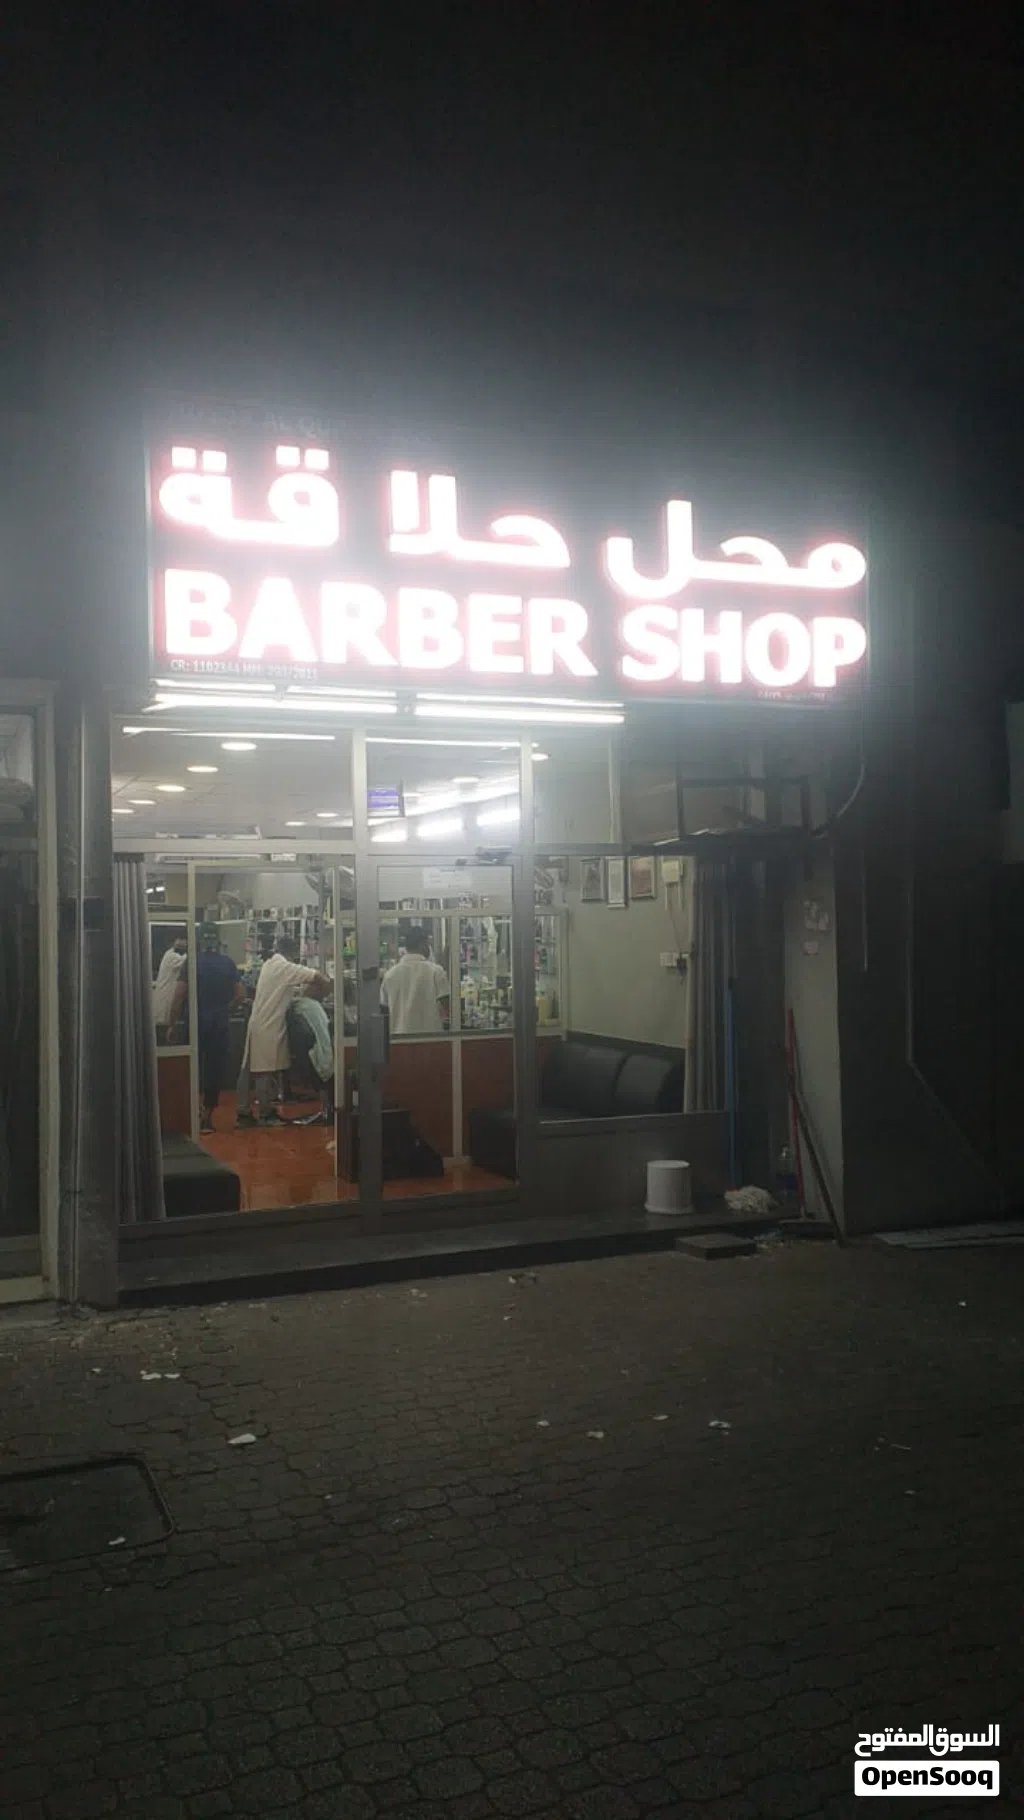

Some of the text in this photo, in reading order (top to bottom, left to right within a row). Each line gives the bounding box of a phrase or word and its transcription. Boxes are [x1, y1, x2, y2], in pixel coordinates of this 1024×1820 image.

[606, 500, 867, 599] محل
[164, 568, 867, 689] BARBER SHOP
